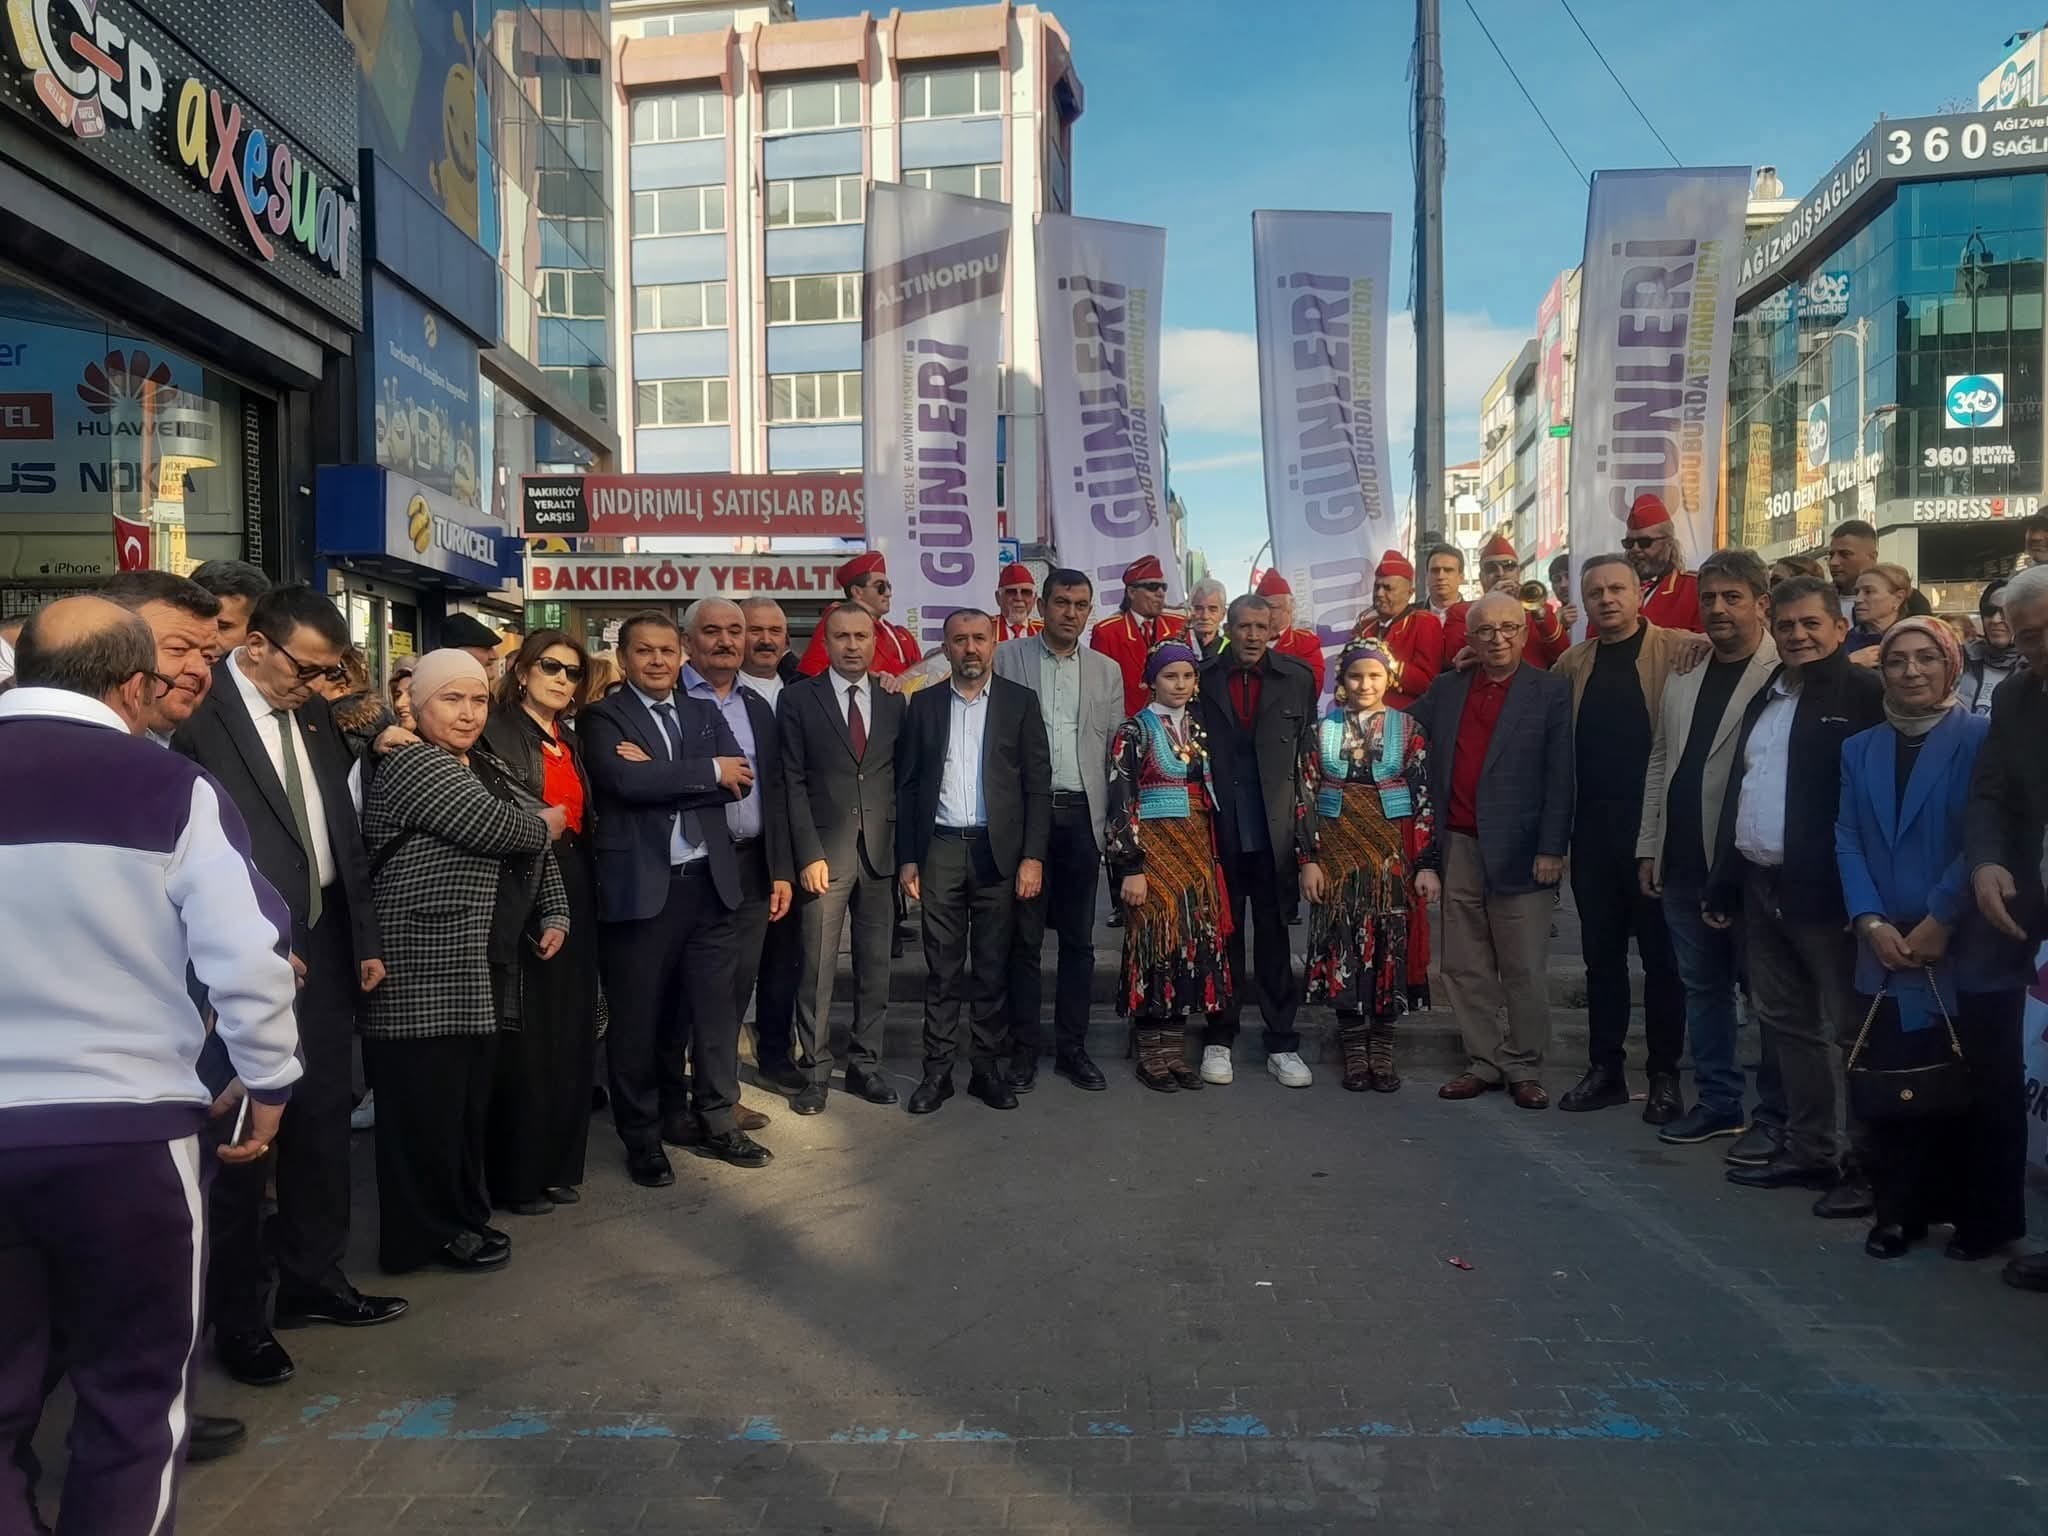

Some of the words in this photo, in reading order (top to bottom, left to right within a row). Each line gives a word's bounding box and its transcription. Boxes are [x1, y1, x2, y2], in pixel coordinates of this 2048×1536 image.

[1887, 122, 1988, 166] 360
[177, 77, 357, 280] axesuar
[874, 252, 999, 311] ALTINORDU
[0, 406, 41, 427] EL
[1058, 274, 1152, 539] GÜNLERİ
[1277, 271, 1369, 536] GÜNLERİ
[77, 420, 181, 437] HUAWEI
[906, 338, 976, 587] GÜNLERİ
[1924, 446, 1967, 468] 360
[528, 485, 582, 498] BAKIRKÖY
[534, 499, 576, 510] YERALTI
[713, 487, 815, 524] SATIŞLAR
[821, 488, 865, 524] BAŞ
[1764, 490, 1791, 521] 360
[1793, 478, 1837, 512] DENTAL
[535, 511, 576, 524] ÇARŞISI
[433, 515, 498, 567] TURKCELL
[54, 562, 101, 574] iPhone
[532, 560, 704, 591] BAKIRKÖY
[709, 565, 842, 591] YERALTI
